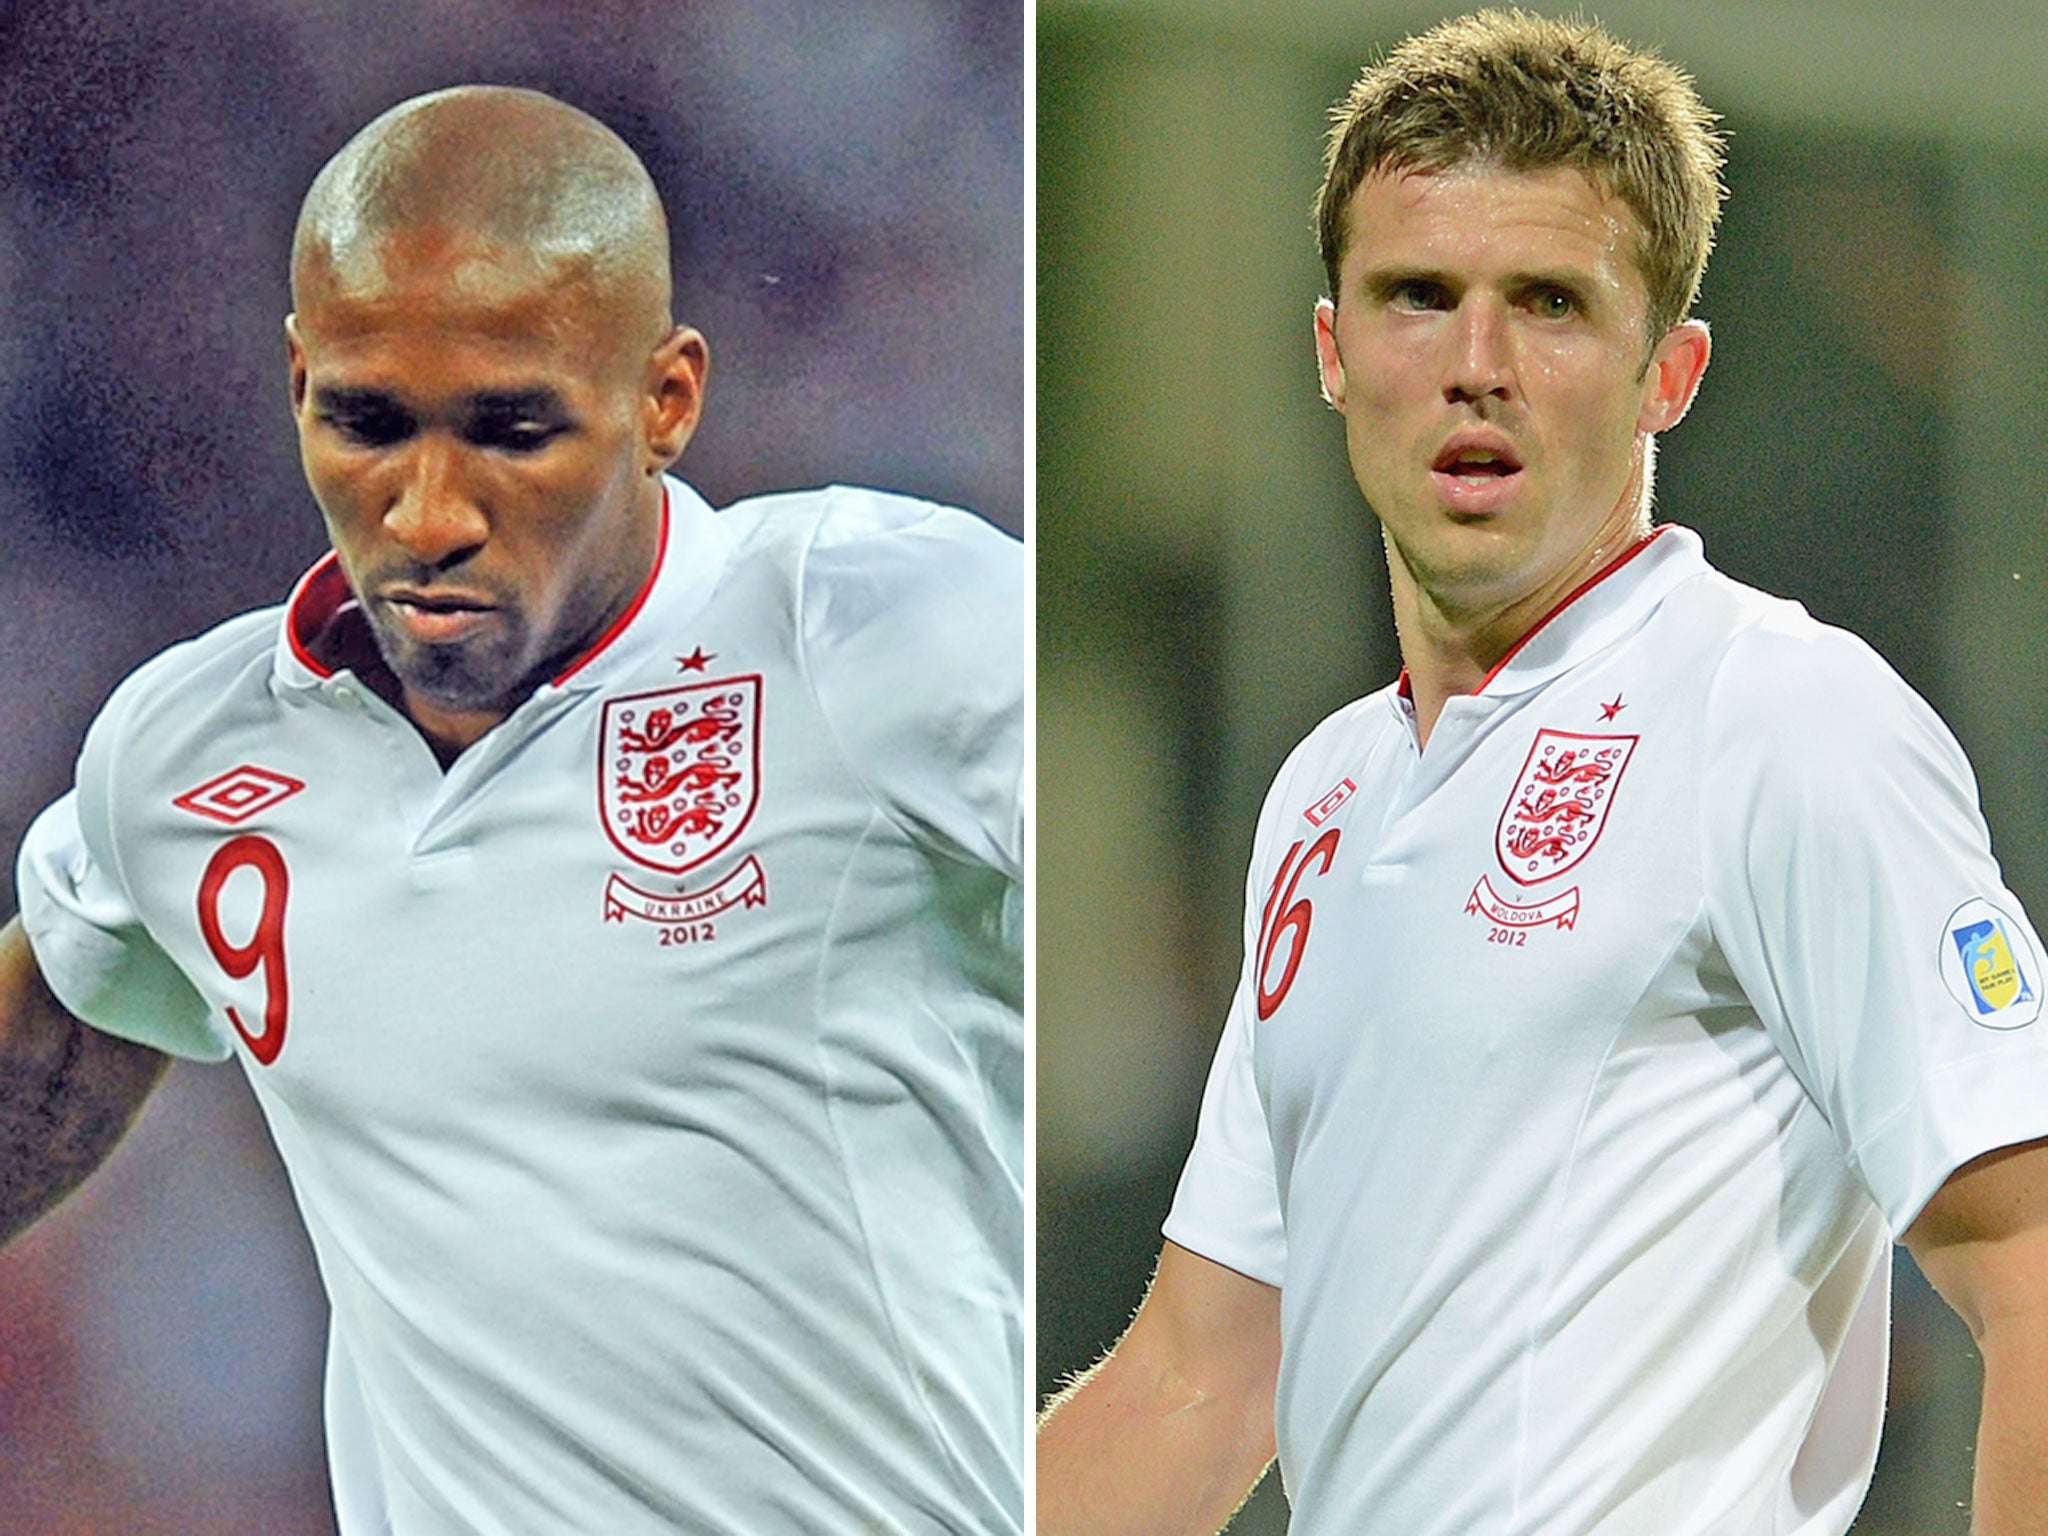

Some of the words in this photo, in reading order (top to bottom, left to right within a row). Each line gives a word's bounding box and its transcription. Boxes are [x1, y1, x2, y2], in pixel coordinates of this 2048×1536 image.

[645, 891, 726, 915] UKRAINE
[1490, 903, 1544, 922] MOLDOVA
[659, 923, 715, 946] 2012
[1254, 828, 1341, 1021] 16
[1488, 927, 1527, 946] 2012
[197, 834, 289, 1066] 9
